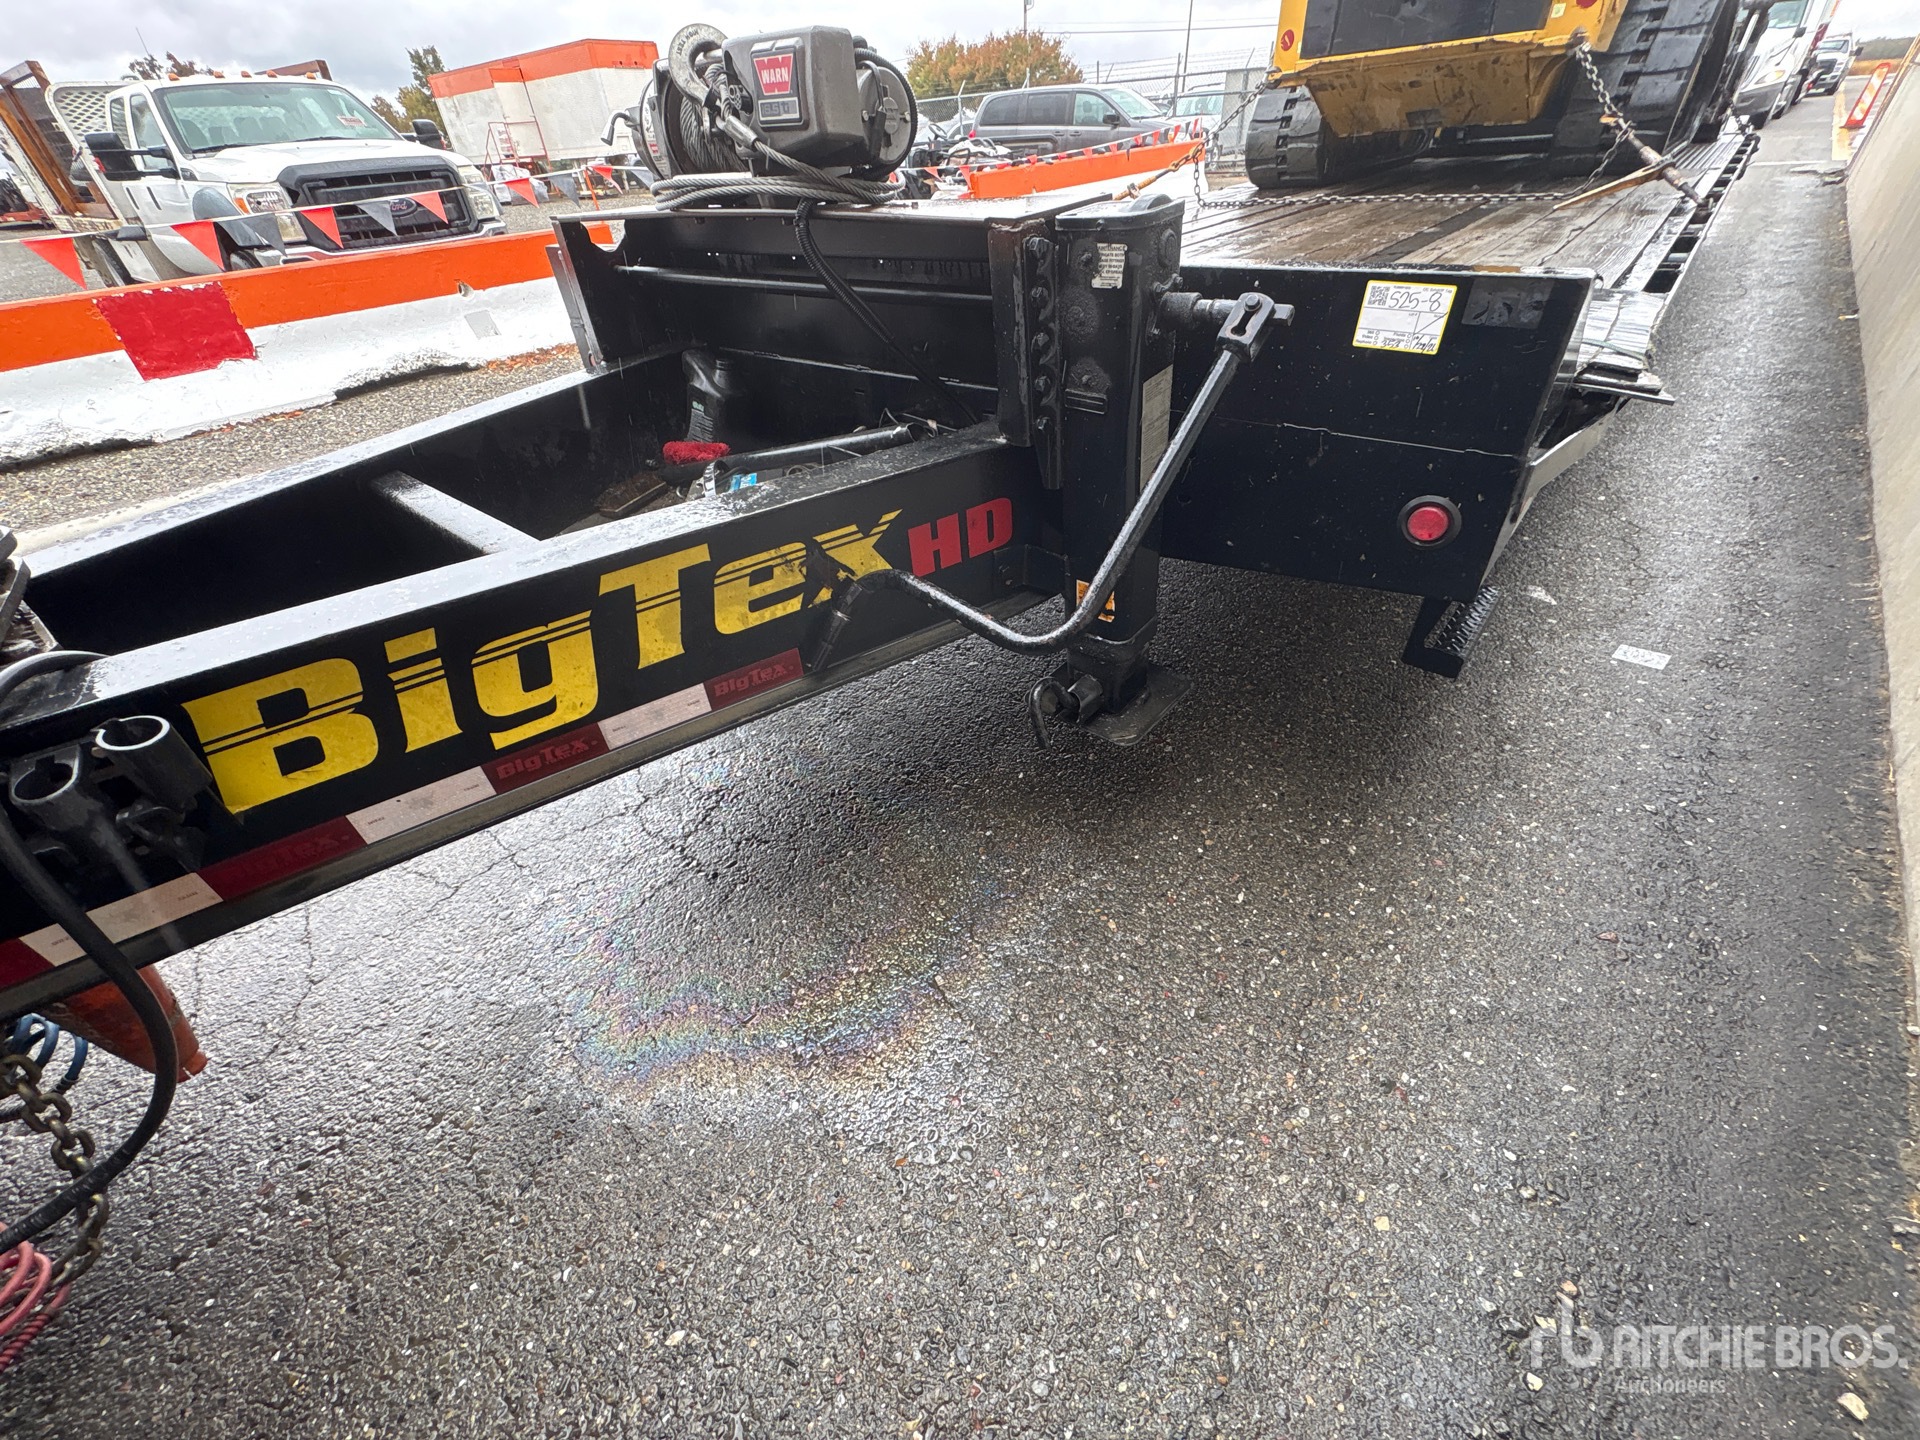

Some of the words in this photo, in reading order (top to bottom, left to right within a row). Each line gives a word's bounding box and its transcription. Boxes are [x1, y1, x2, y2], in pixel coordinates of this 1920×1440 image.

[761, 66, 789, 84] WARN
[909, 497, 1014, 578] HD
[713, 664, 787, 697] BigTex
[495, 738, 590, 779] BigTex
